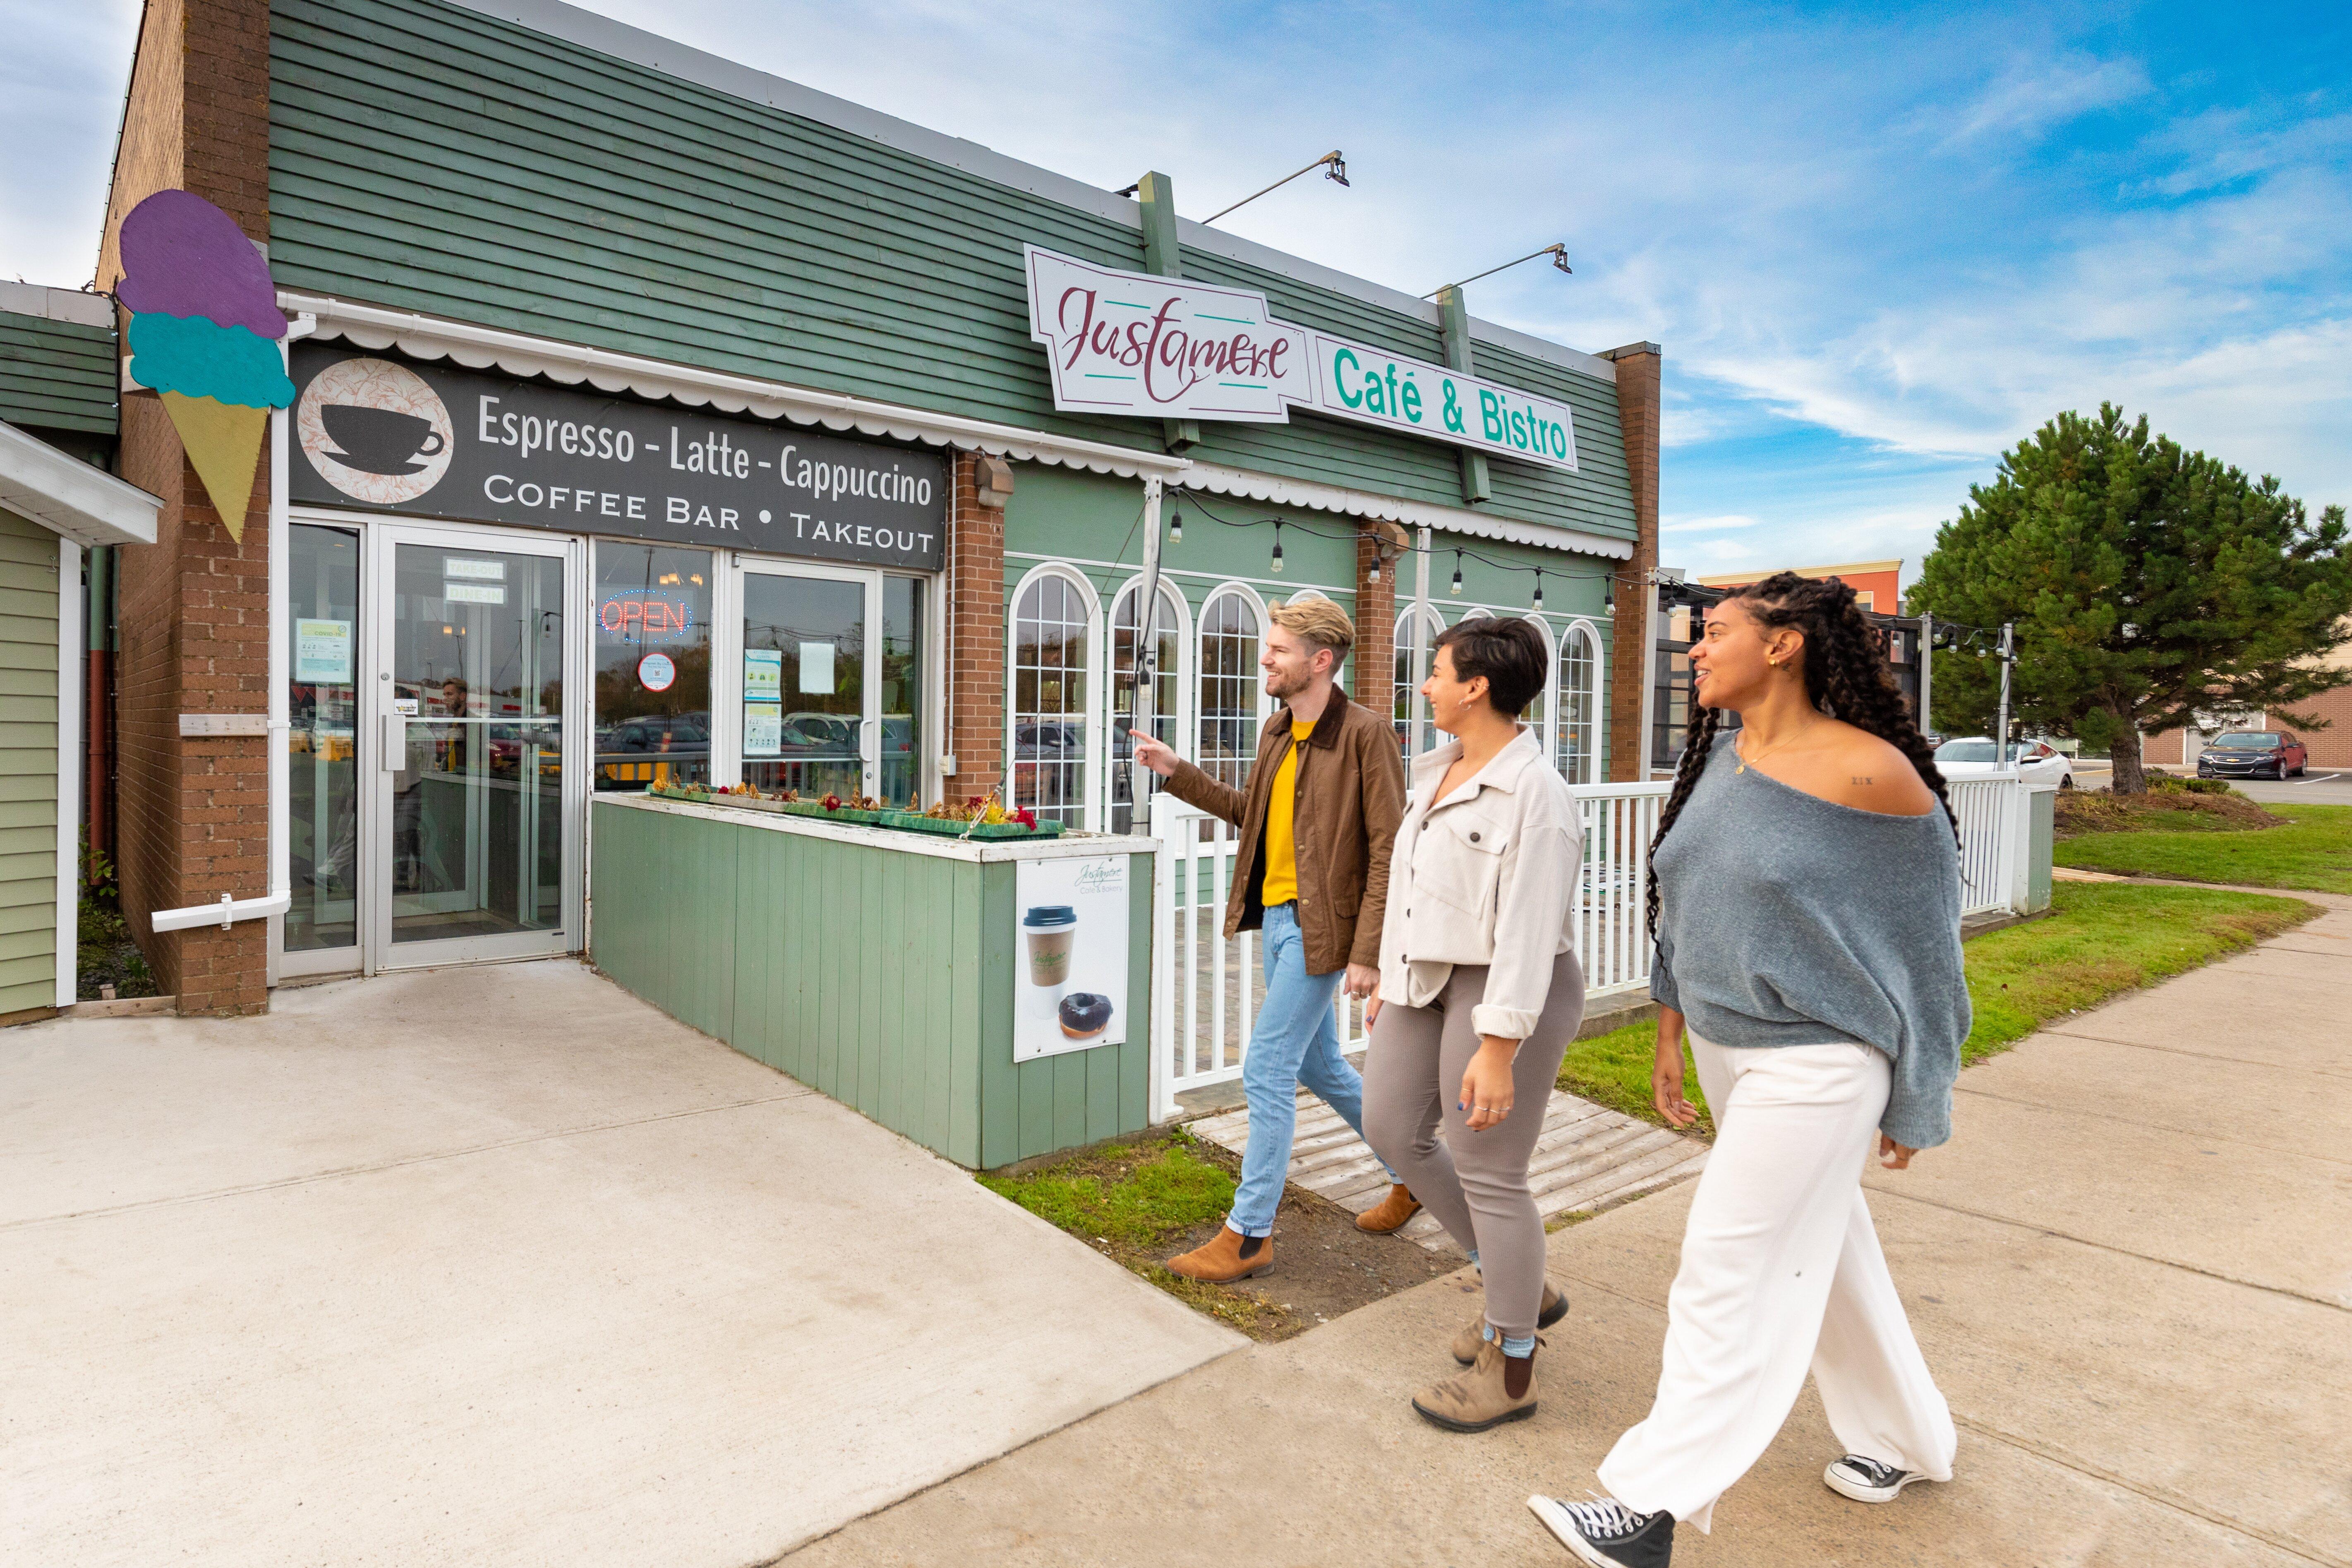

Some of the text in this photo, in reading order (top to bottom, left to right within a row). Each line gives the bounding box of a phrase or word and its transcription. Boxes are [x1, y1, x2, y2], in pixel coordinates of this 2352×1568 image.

[1059, 287, 1289, 403] Justamere
[1334, 348, 1566, 460] Café & Bistro
[479, 394, 634, 462] Espresso
[671, 426, 749, 479] Latte
[781, 445, 931, 506] Cappuccino
[484, 475, 933, 553] COFFEE BAR TAKEOUT
[449, 563, 502, 575] TAKE-OUT
[450, 587, 501, 601] DINE-IN
[601, 601, 684, 632] OPEN
